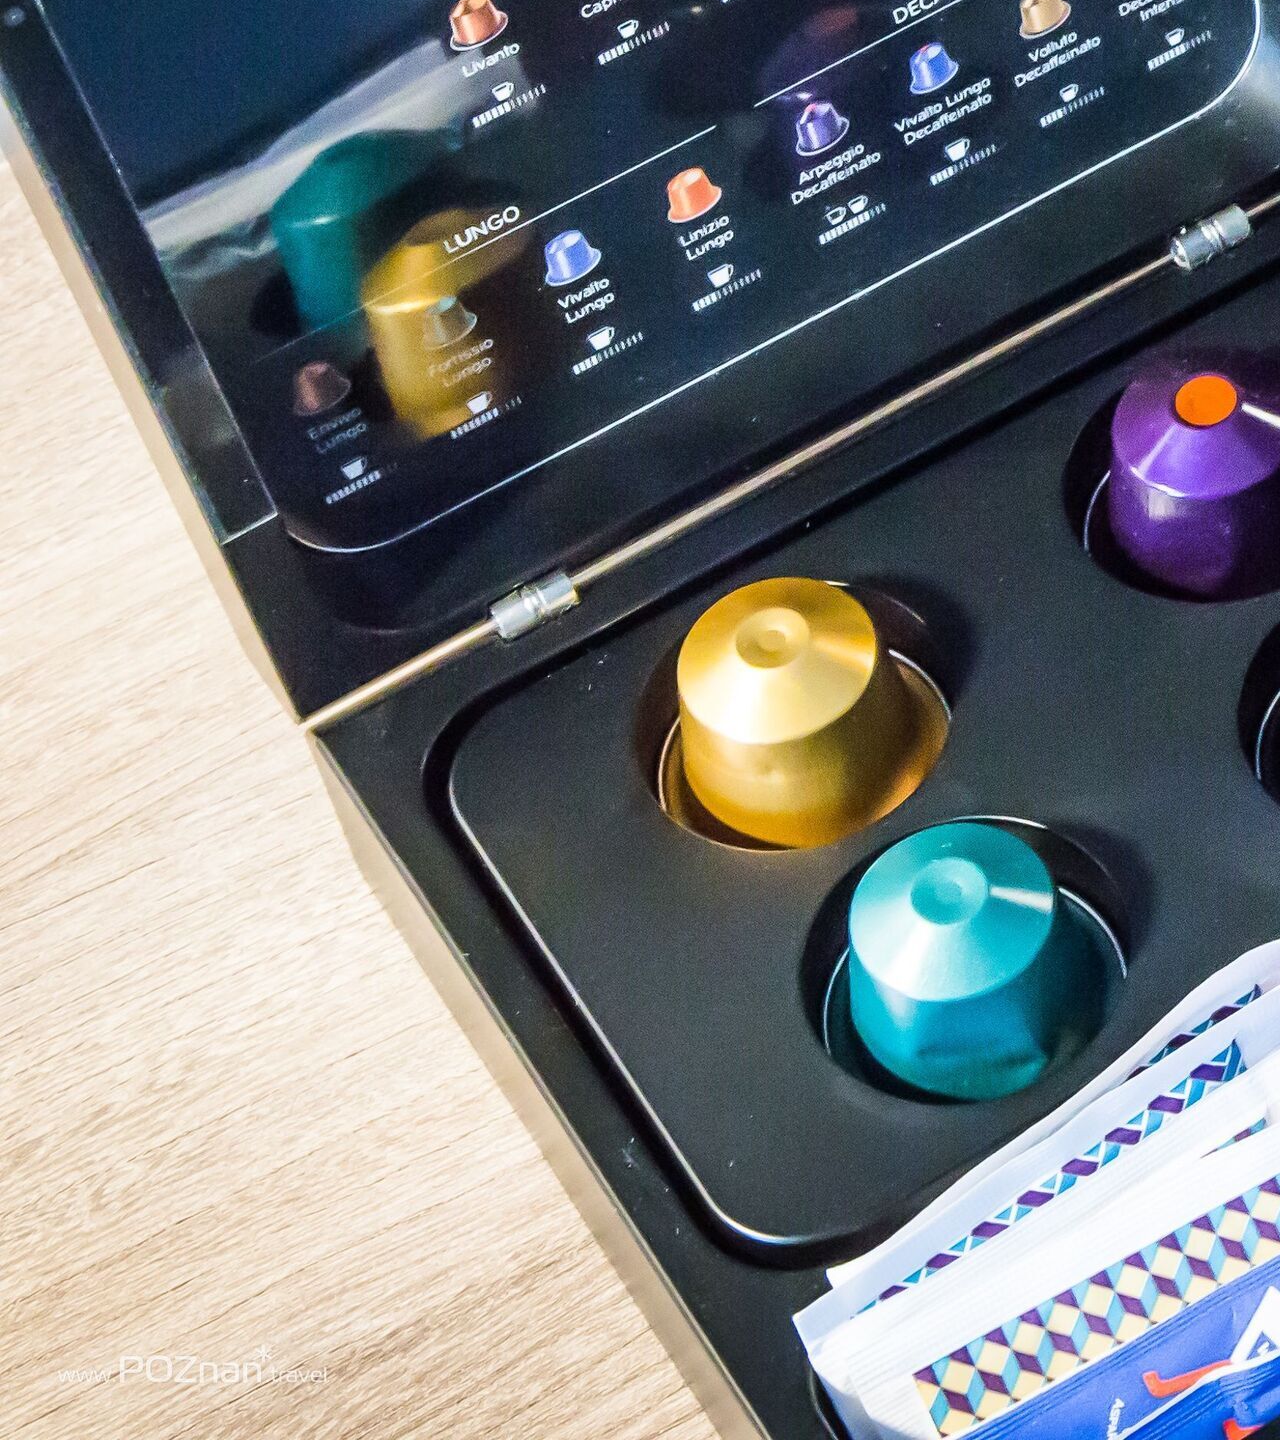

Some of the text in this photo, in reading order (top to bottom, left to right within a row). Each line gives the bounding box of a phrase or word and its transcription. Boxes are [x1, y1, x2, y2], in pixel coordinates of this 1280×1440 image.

[462, 42, 521, 79] Livanto
[1014, 34, 1102, 89] Decaffeinato
[1027, 31, 1078, 63] Volluto
[894, 75, 992, 134] Vivalto Lungo
[904, 92, 992, 146] Decaffeinato
[791, 151, 881, 205] Decaffeinato
[798, 143, 865, 186] Arpeggio
[442, 206, 521, 255] LUNGO
[679, 215, 731, 246] Linizio
[685, 230, 735, 262] Lungo
[557, 277, 611, 309] Vivalto
[564, 292, 616, 325] Lungo
[442, 357, 493, 388] Lungo
[315, 423, 367, 455] Lungo
